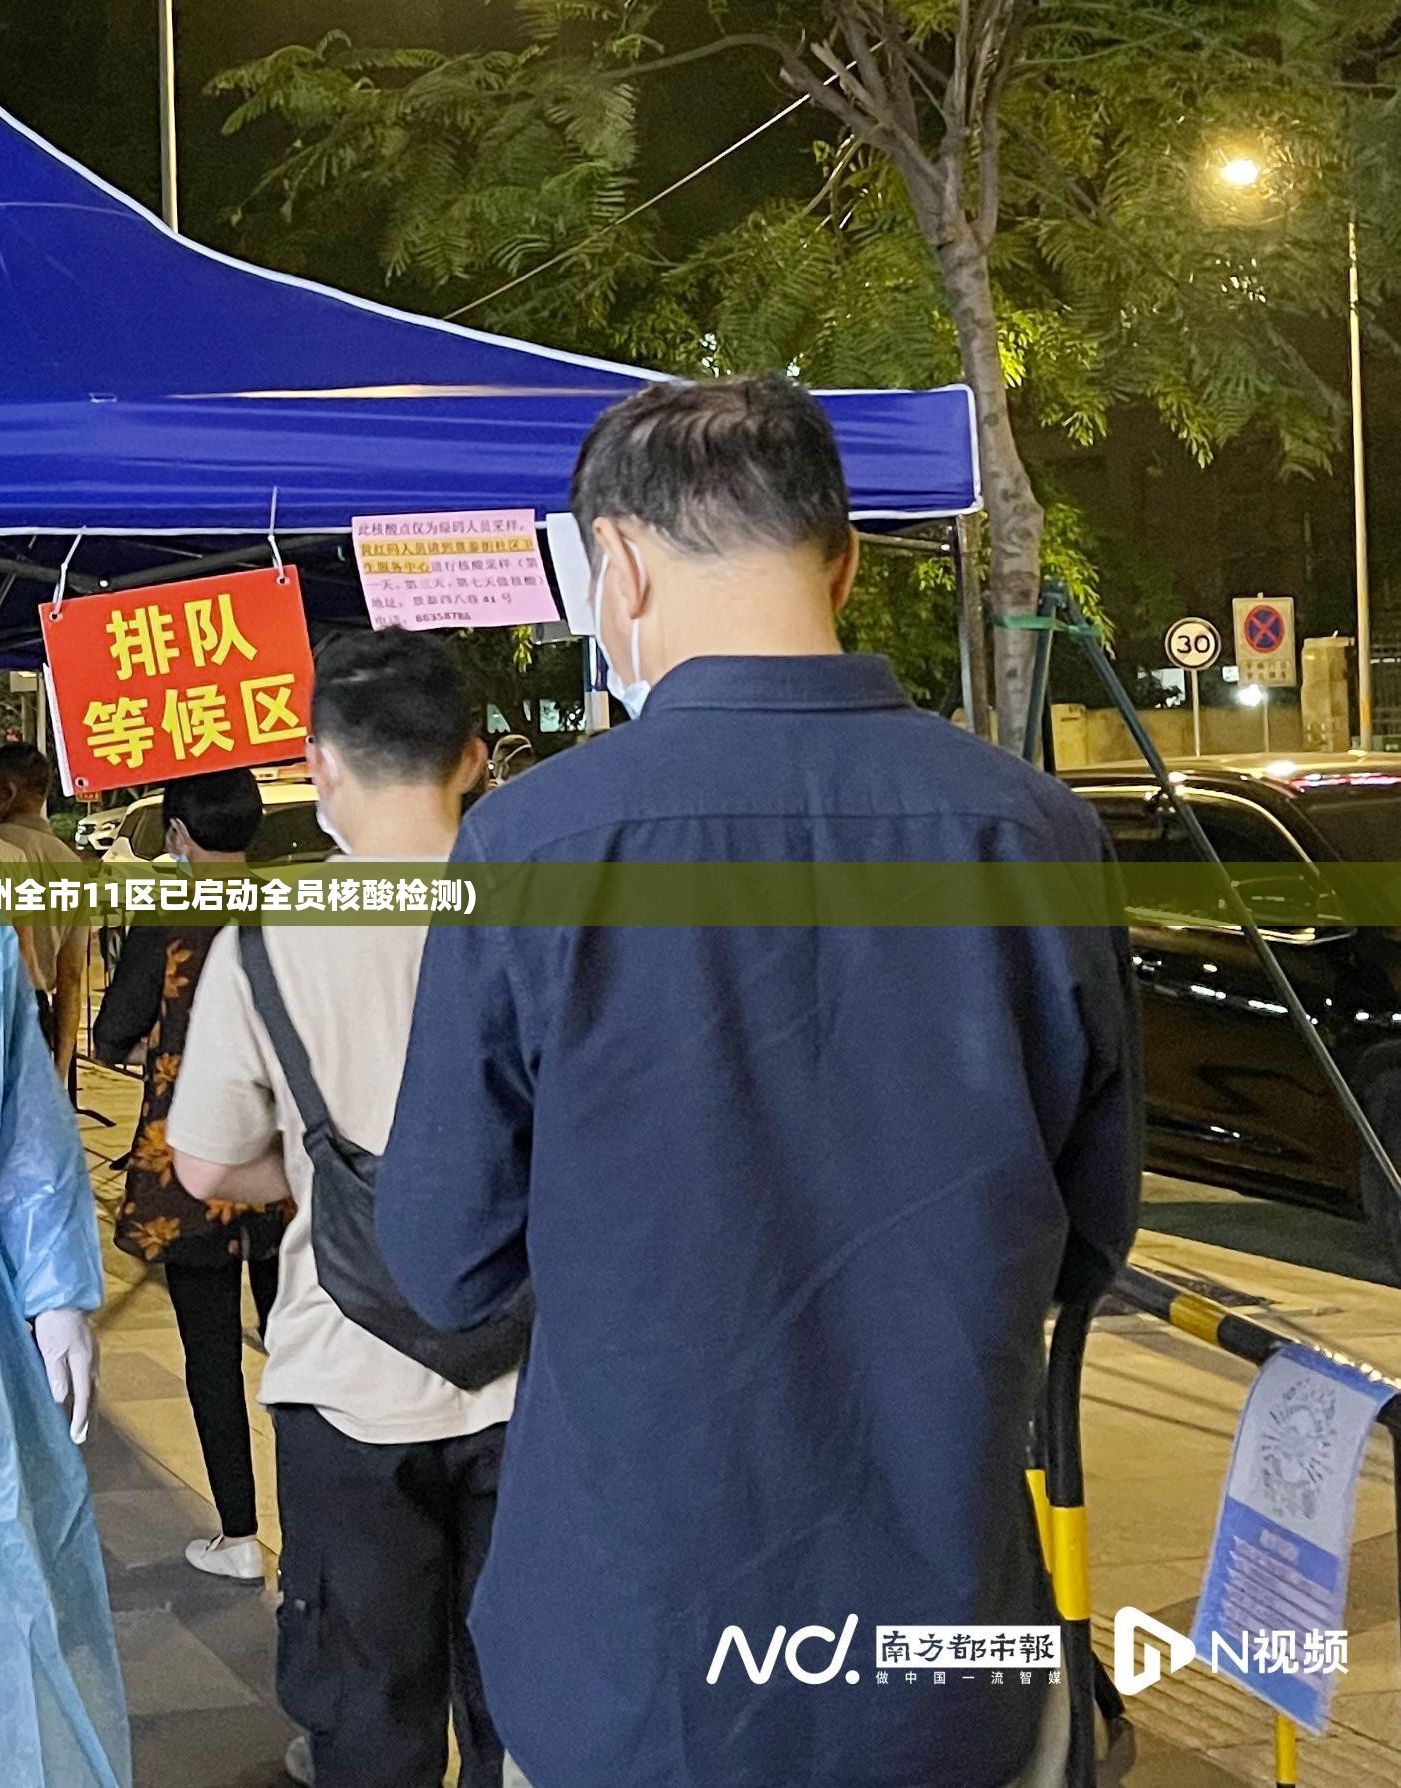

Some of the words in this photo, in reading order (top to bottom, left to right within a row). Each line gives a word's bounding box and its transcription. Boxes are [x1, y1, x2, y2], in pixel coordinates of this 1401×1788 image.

[105, 593, 257, 681] 排队
[1176, 635, 1211, 654] 30
[83, 673, 307, 769] 等候区
